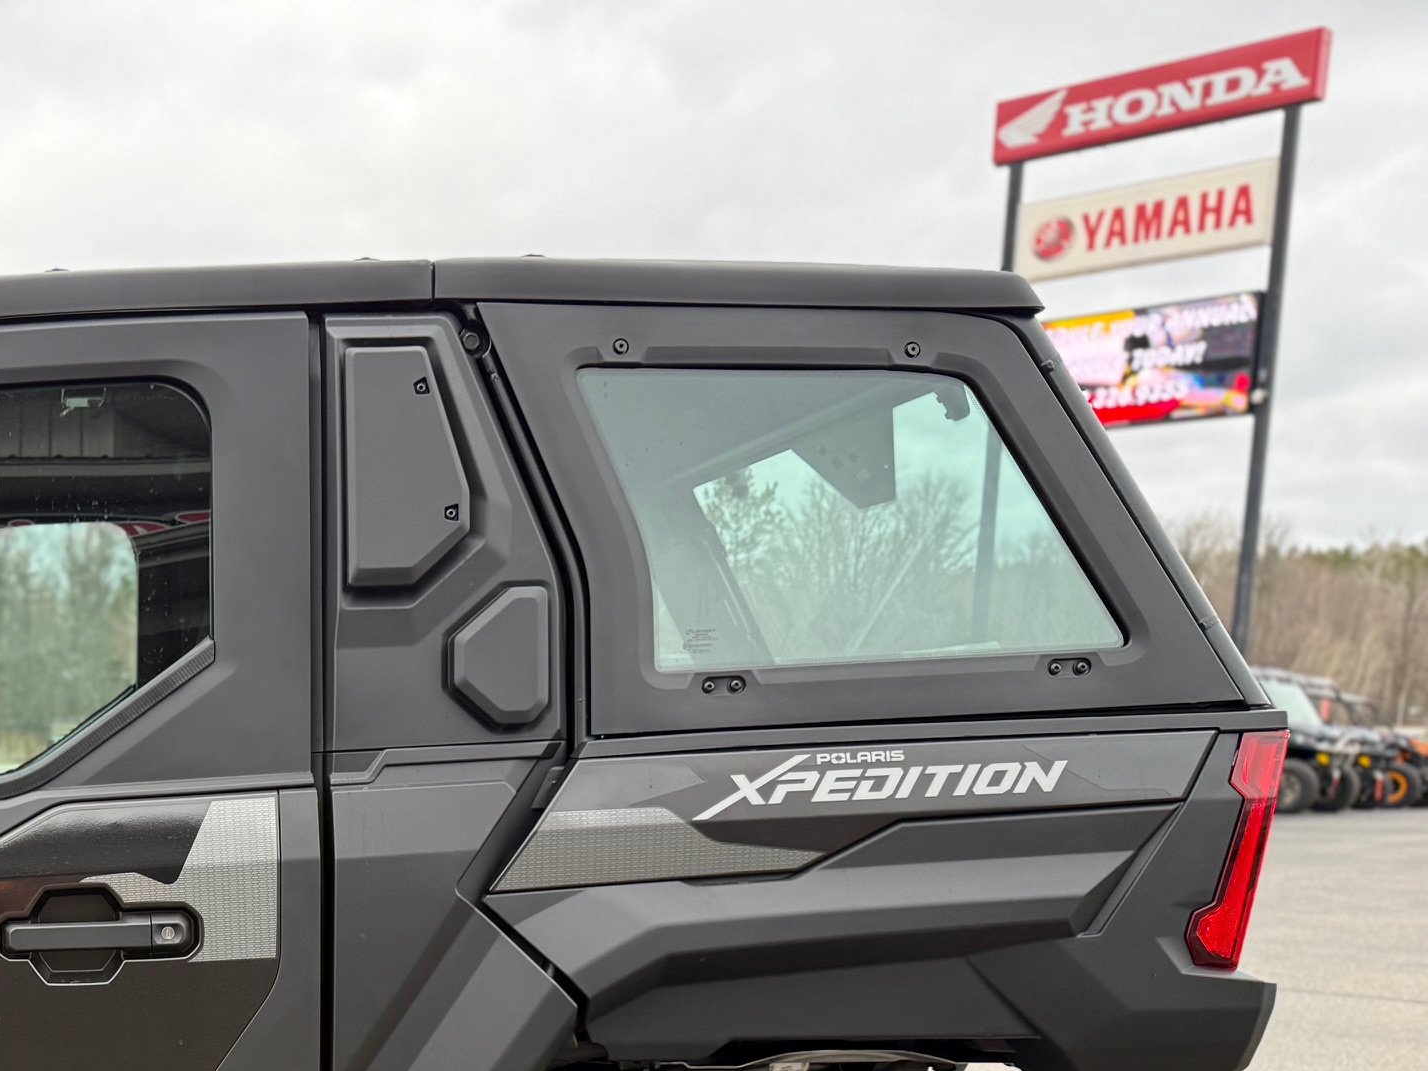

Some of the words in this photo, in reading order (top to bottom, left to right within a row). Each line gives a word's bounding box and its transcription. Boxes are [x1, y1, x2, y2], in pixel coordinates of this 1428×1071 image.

[1062, 56, 1311, 137] HONDA
[1082, 184, 1254, 251] YAMAHA
[692, 754, 1068, 821] XPEDITION
[816, 749, 905, 765] POLARIS
